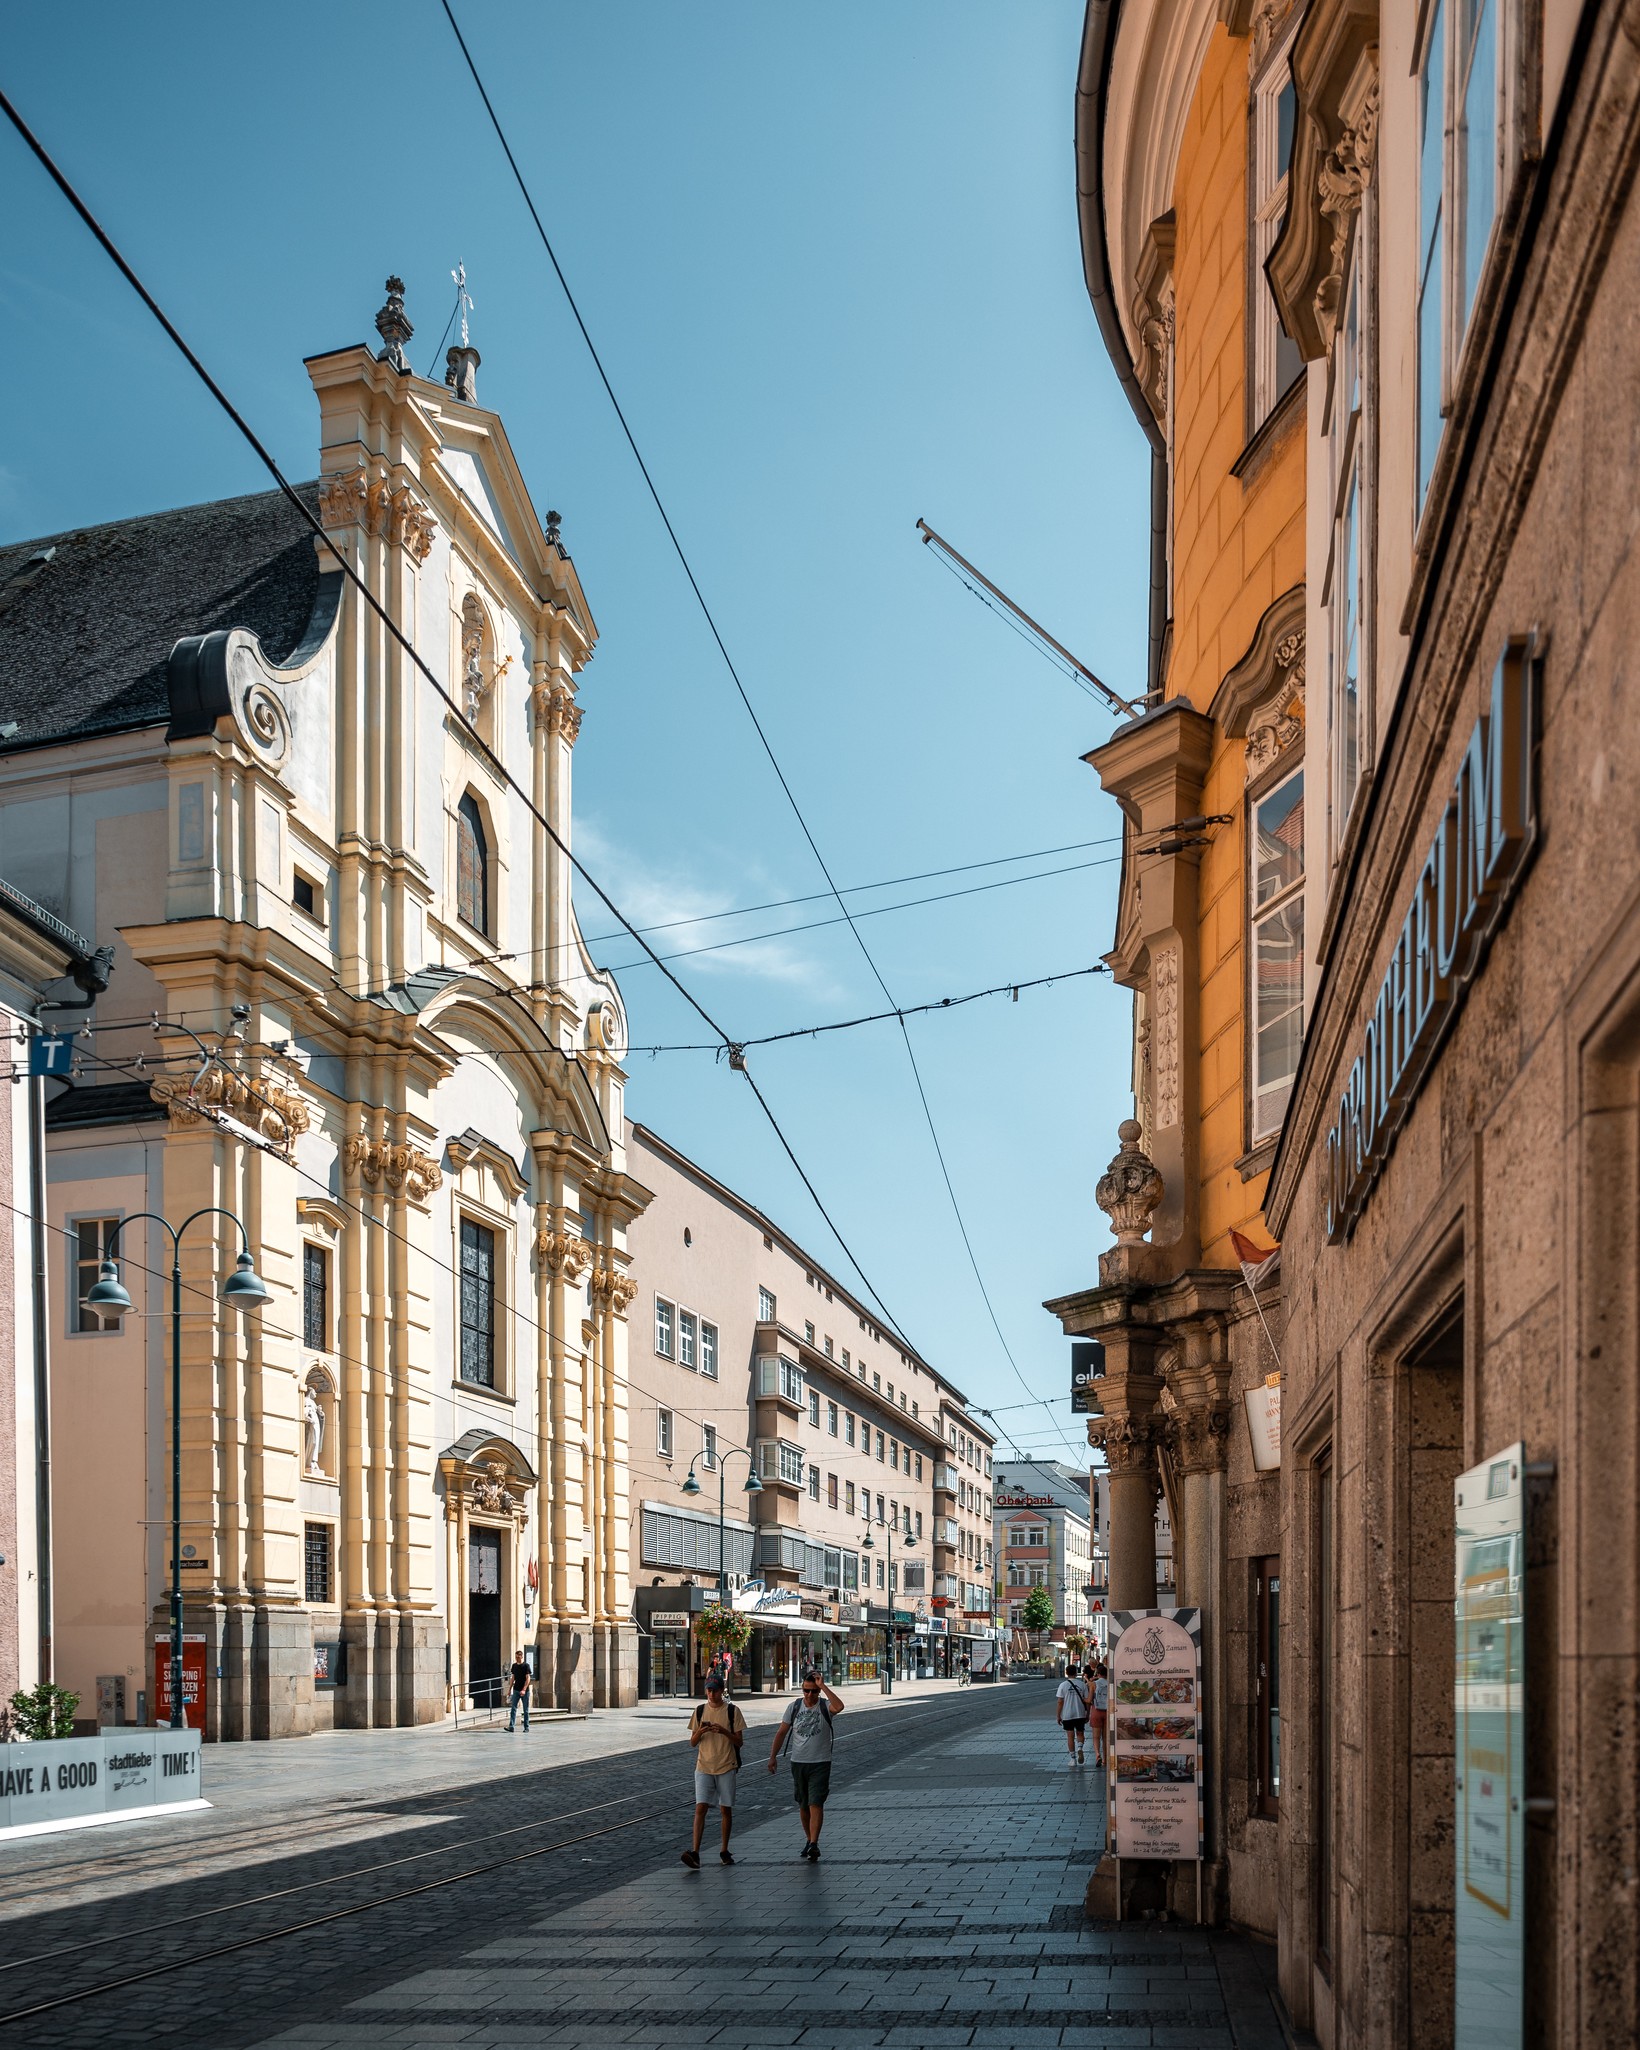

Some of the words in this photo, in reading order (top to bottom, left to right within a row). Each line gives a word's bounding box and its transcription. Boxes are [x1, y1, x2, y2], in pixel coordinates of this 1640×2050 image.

[41, 1041, 64, 1068] T
[996, 1494, 1055, 1506] Oberbank
[1091, 1598, 1106, 1612] A1
[1124, 1646, 1143, 1655] Ayam
[109, 1752, 152, 1771] stadtliebe
[40, 1766, 51, 1793] A
[58, 1761, 97, 1790] GOOD
[1133, 1786, 1158, 1794] Gastgarten
